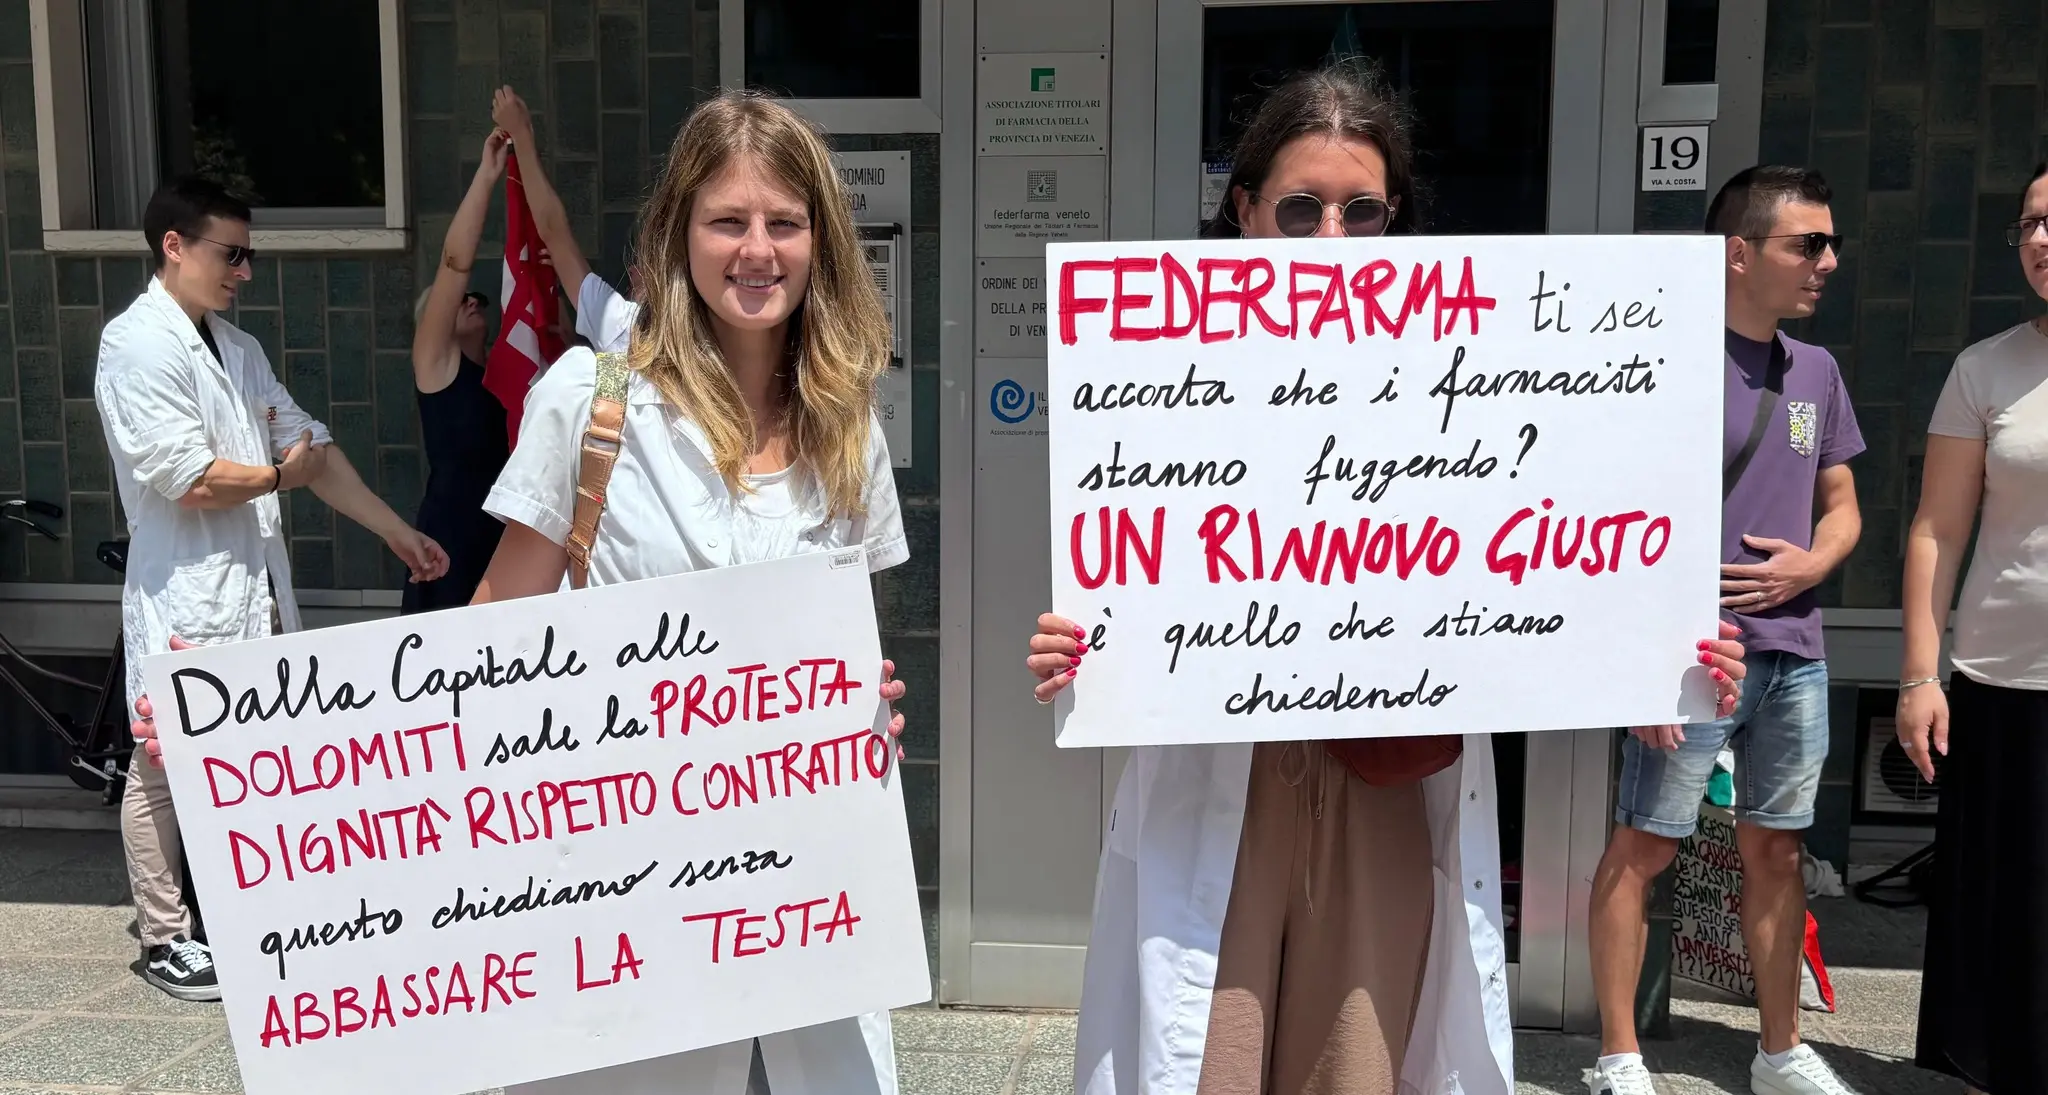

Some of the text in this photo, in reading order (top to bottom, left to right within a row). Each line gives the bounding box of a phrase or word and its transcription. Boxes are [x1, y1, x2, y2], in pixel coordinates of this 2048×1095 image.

[985, 99, 1101, 109] ASSOCIAZIONE TITOLARI
[995, 117, 1090, 126] DI FARMACIA DELLA
[989, 134, 1096, 143] PROVINCIA DI VENEZIA
[1649, 136, 1700, 170] 19
[1673, 178, 1697, 186] COSTA
[993, 209, 1091, 220] federfarma veneto
[981, 277, 1017, 290] ORDINE
[1022, 277, 1038, 290] DEI
[991, 302, 1026, 314] DELLA
[1059, 252, 1663, 345] FEDERFARMA ti sei
[1009, 324, 1020, 337] DI
[1074, 364, 1234, 412] accorta
[1370, 367, 1399, 403] i
[1429, 346, 1664, 433] farmacisti
[1078, 424, 1537, 505] stanno fuggendo?
[1071, 506, 1165, 589] UN
[1198, 504, 1460, 585] RINNOVO
[1088, 601, 1563, 674] è quello che stiamo
[171, 612, 719, 737] Dalla Capitale alle
[1225, 669, 1458, 715] chiedendo
[203, 659, 861, 808] DOLOMITI sale la PROTESTA
[229, 729, 889, 889] DIGNITÀ RISPETTO CONTRATTO
[261, 850, 792, 980] questo chiediamo senza
[260, 891, 861, 1048] ABBASSARE LA TESTA
